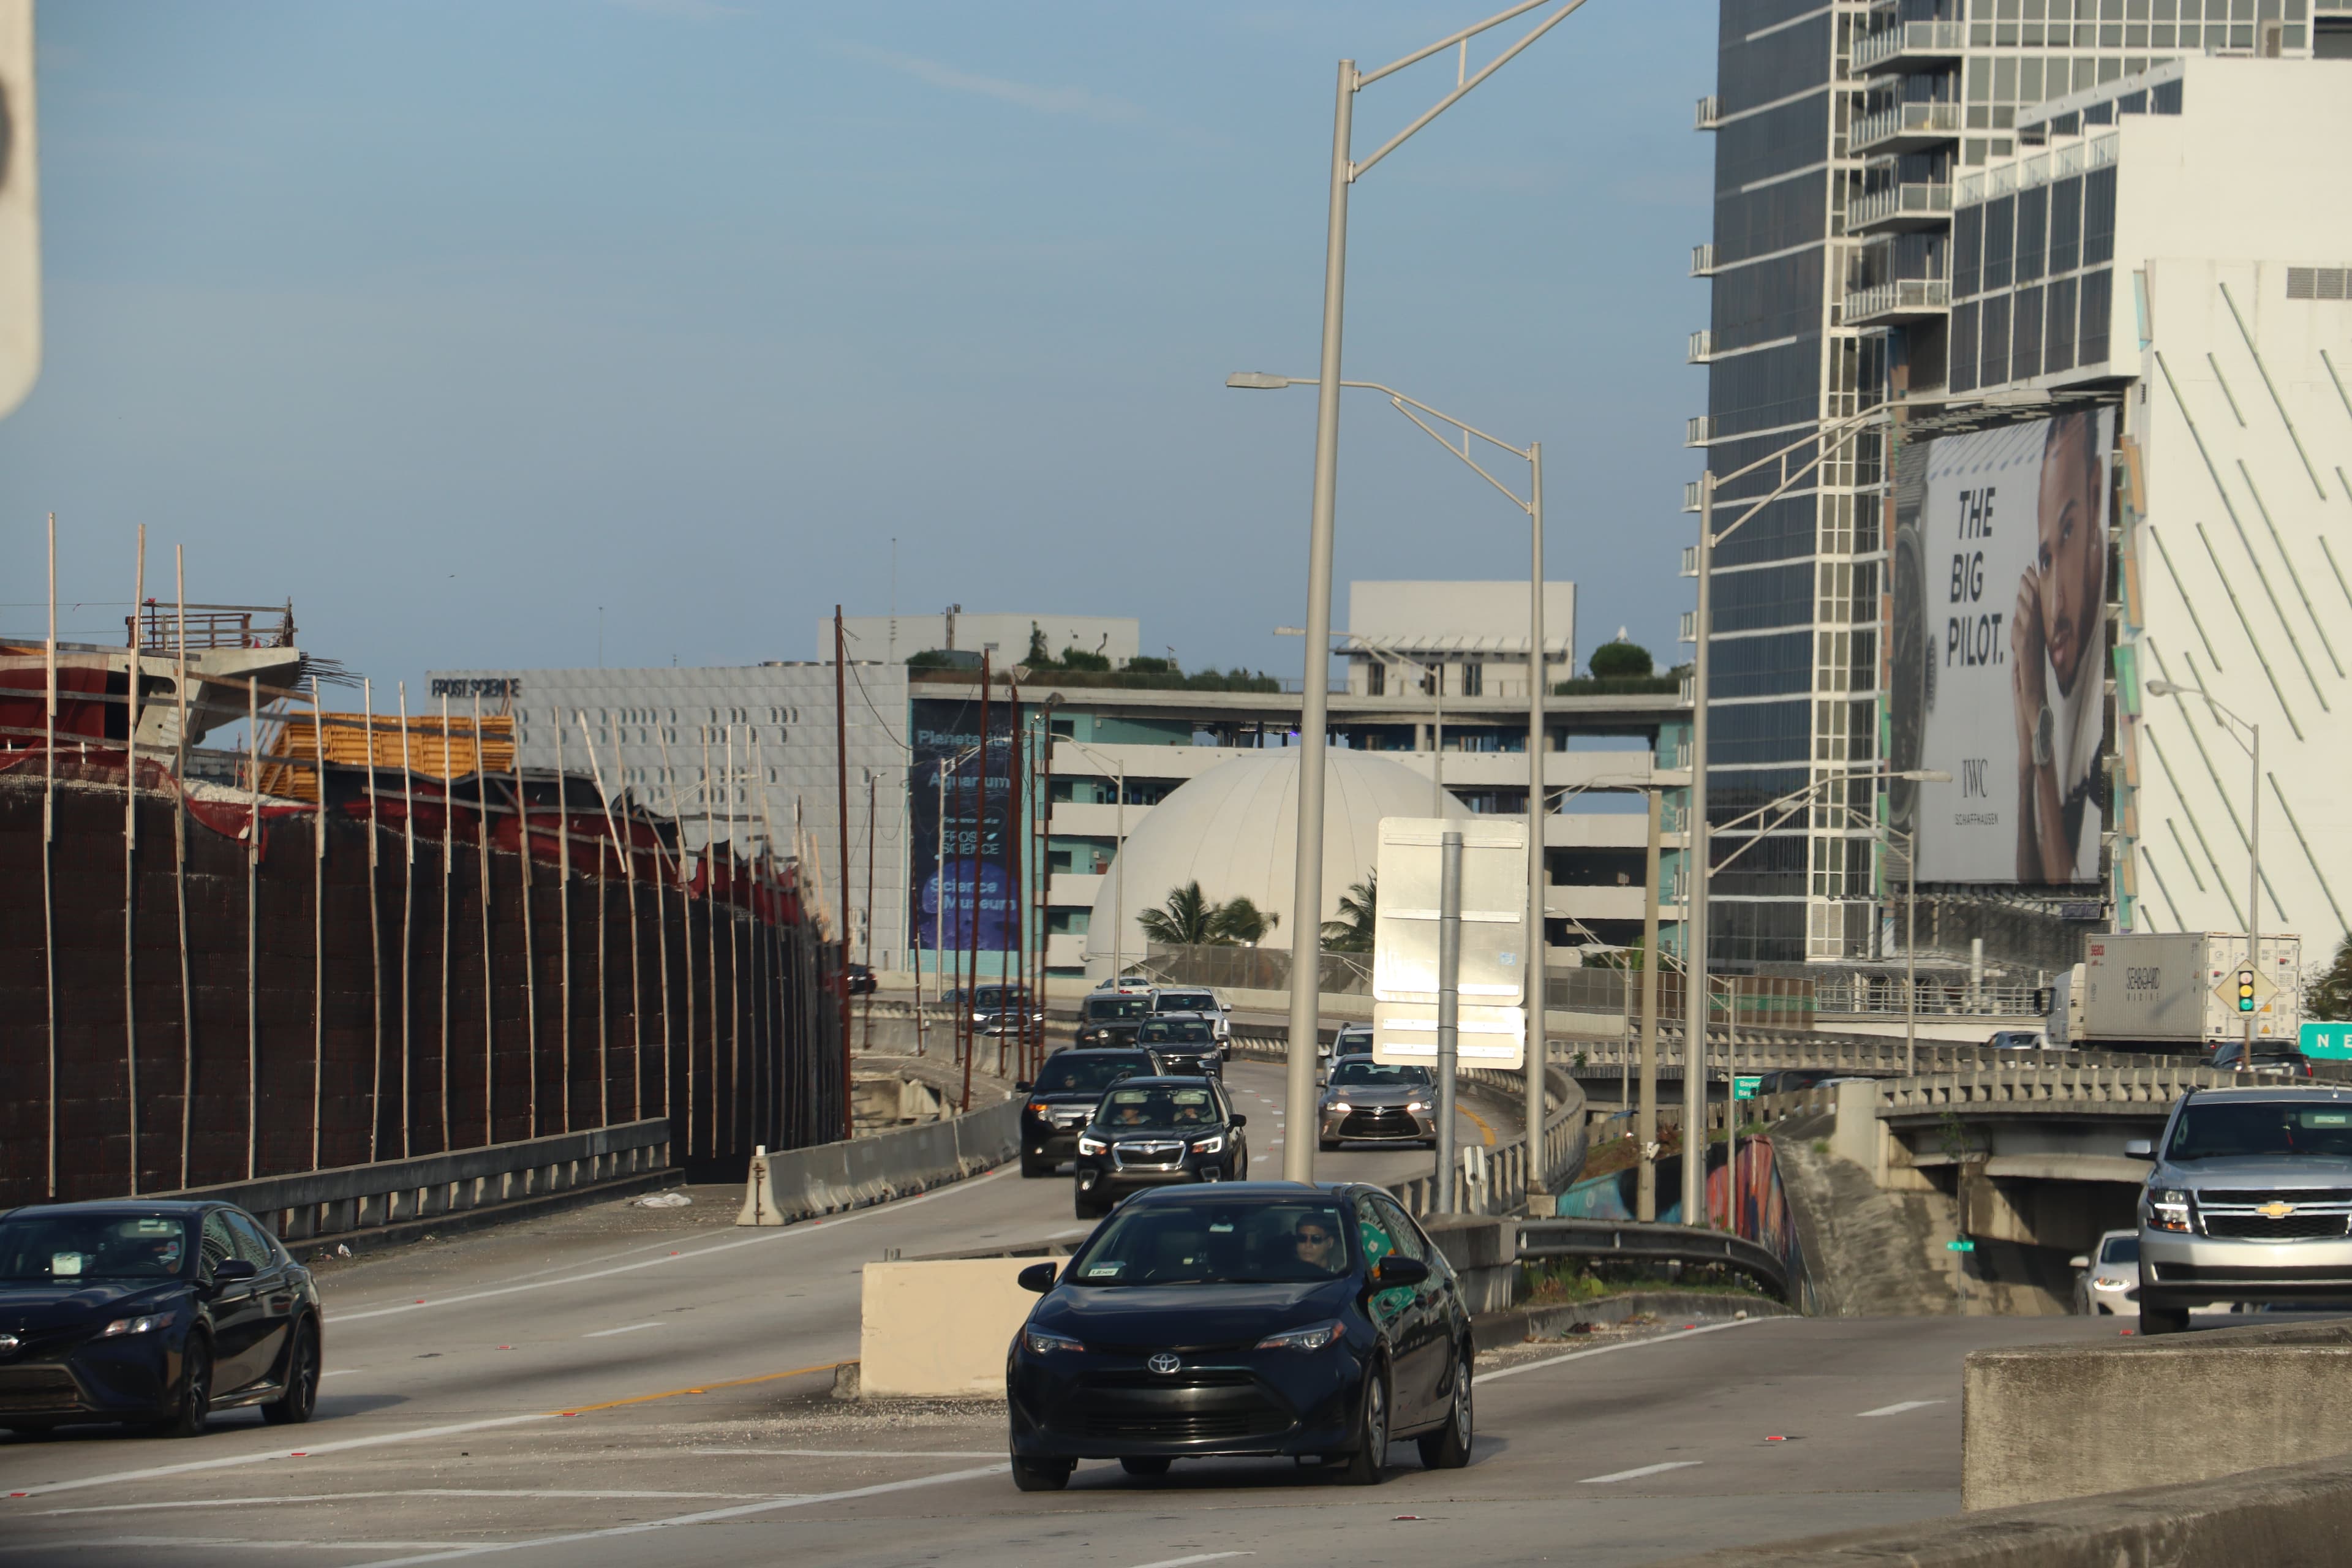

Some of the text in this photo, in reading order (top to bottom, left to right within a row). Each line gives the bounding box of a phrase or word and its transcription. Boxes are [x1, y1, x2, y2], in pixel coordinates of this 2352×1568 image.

[1959, 487, 1996, 540] THE
[1950, 551, 1984, 603] BIG
[1947, 613, 2004, 668] PILOT.
[432, 678, 468, 697] FROST
[928, 771, 1011, 790] Aquarum
[1962, 758, 1989, 799] IWC
[2316, 1033, 2352, 1049] N E
